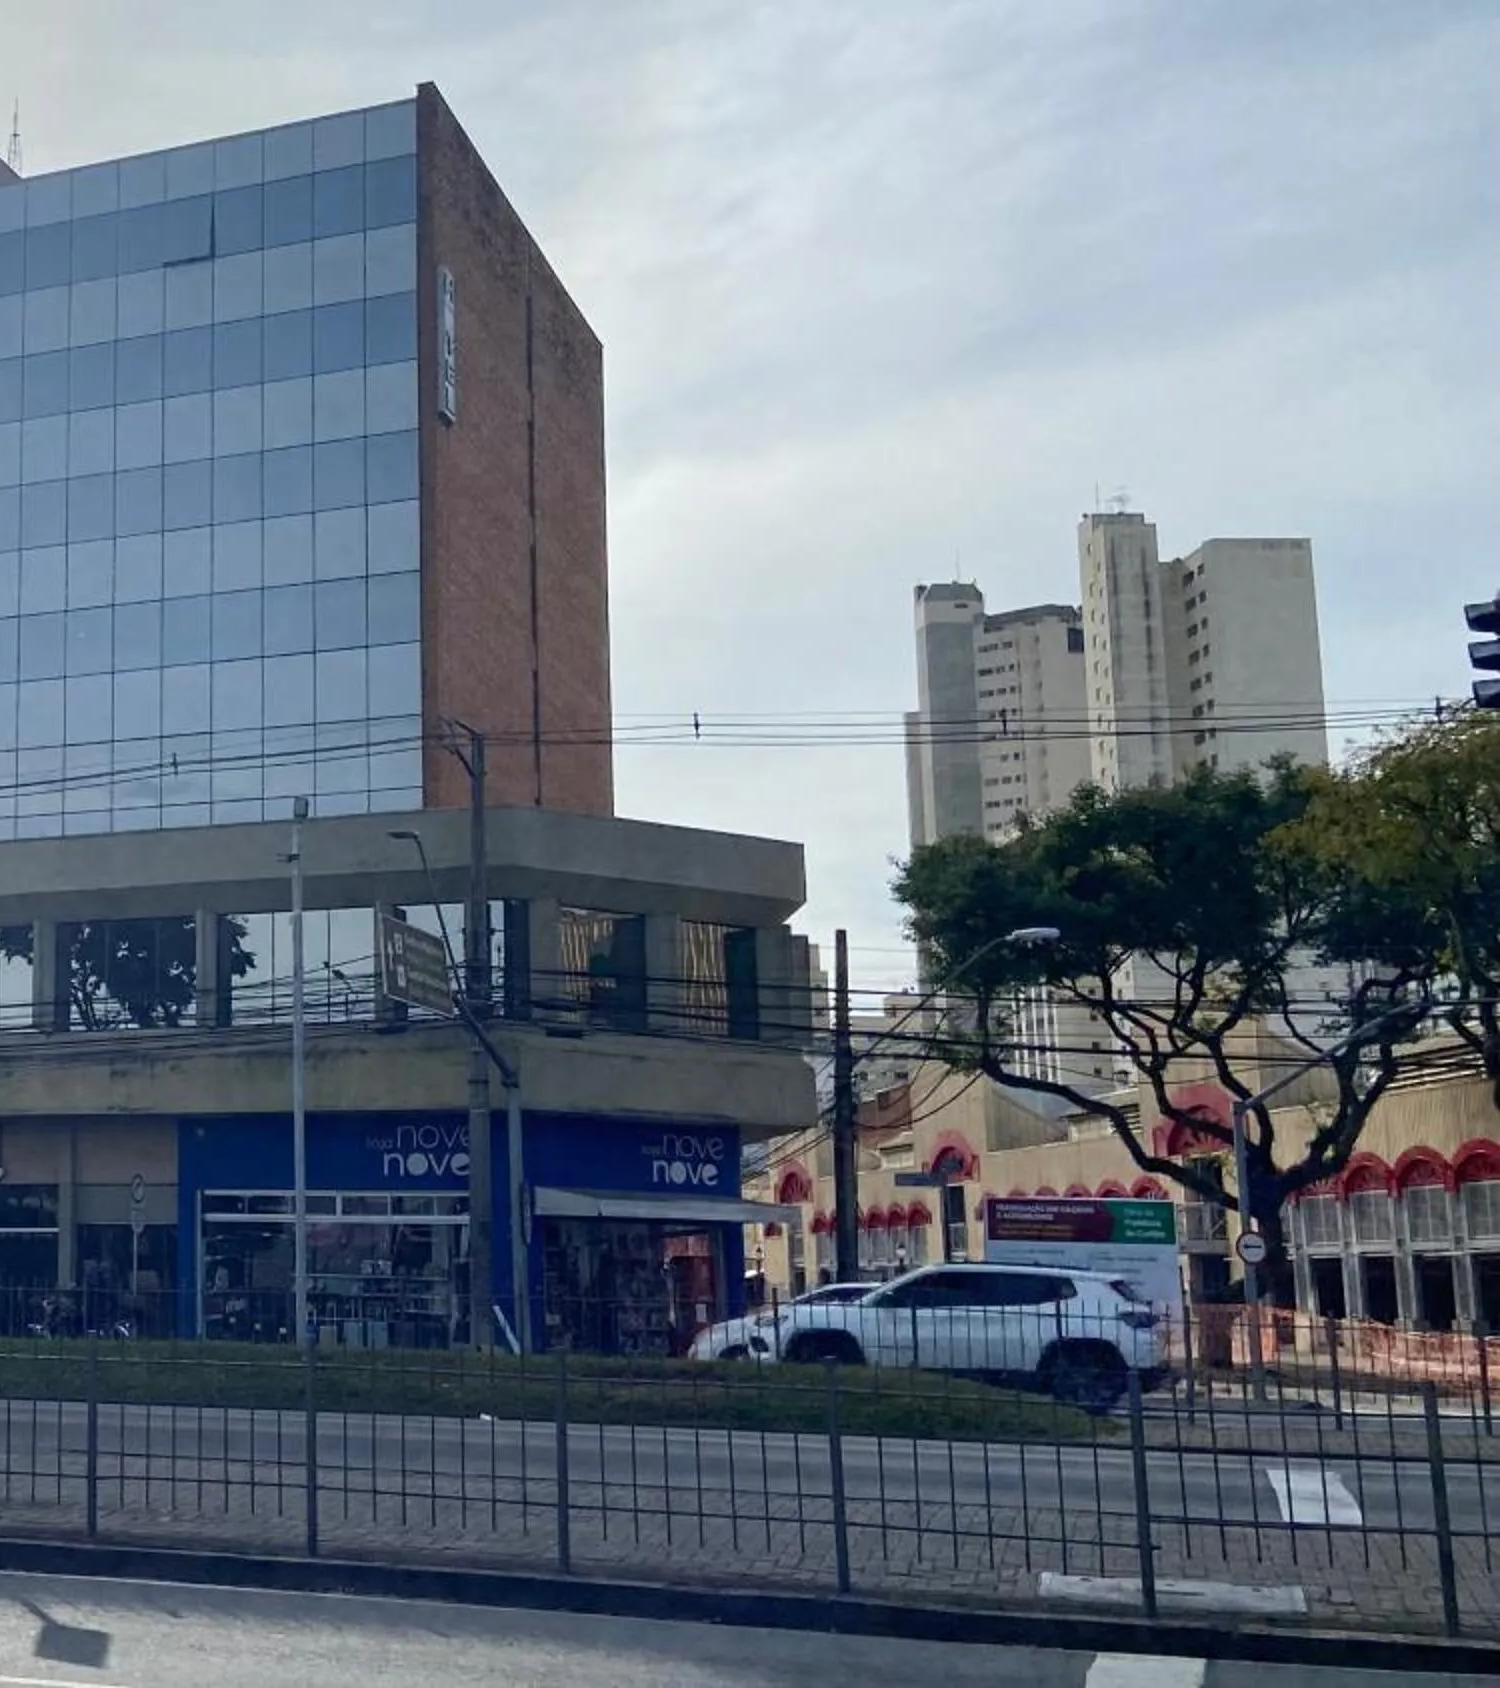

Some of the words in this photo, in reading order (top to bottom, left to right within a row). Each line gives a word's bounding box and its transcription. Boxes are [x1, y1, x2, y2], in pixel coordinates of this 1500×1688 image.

[663, 1133, 724, 1160] nove
[383, 1152, 471, 1177] nove
[652, 1160, 719, 1187] nove
